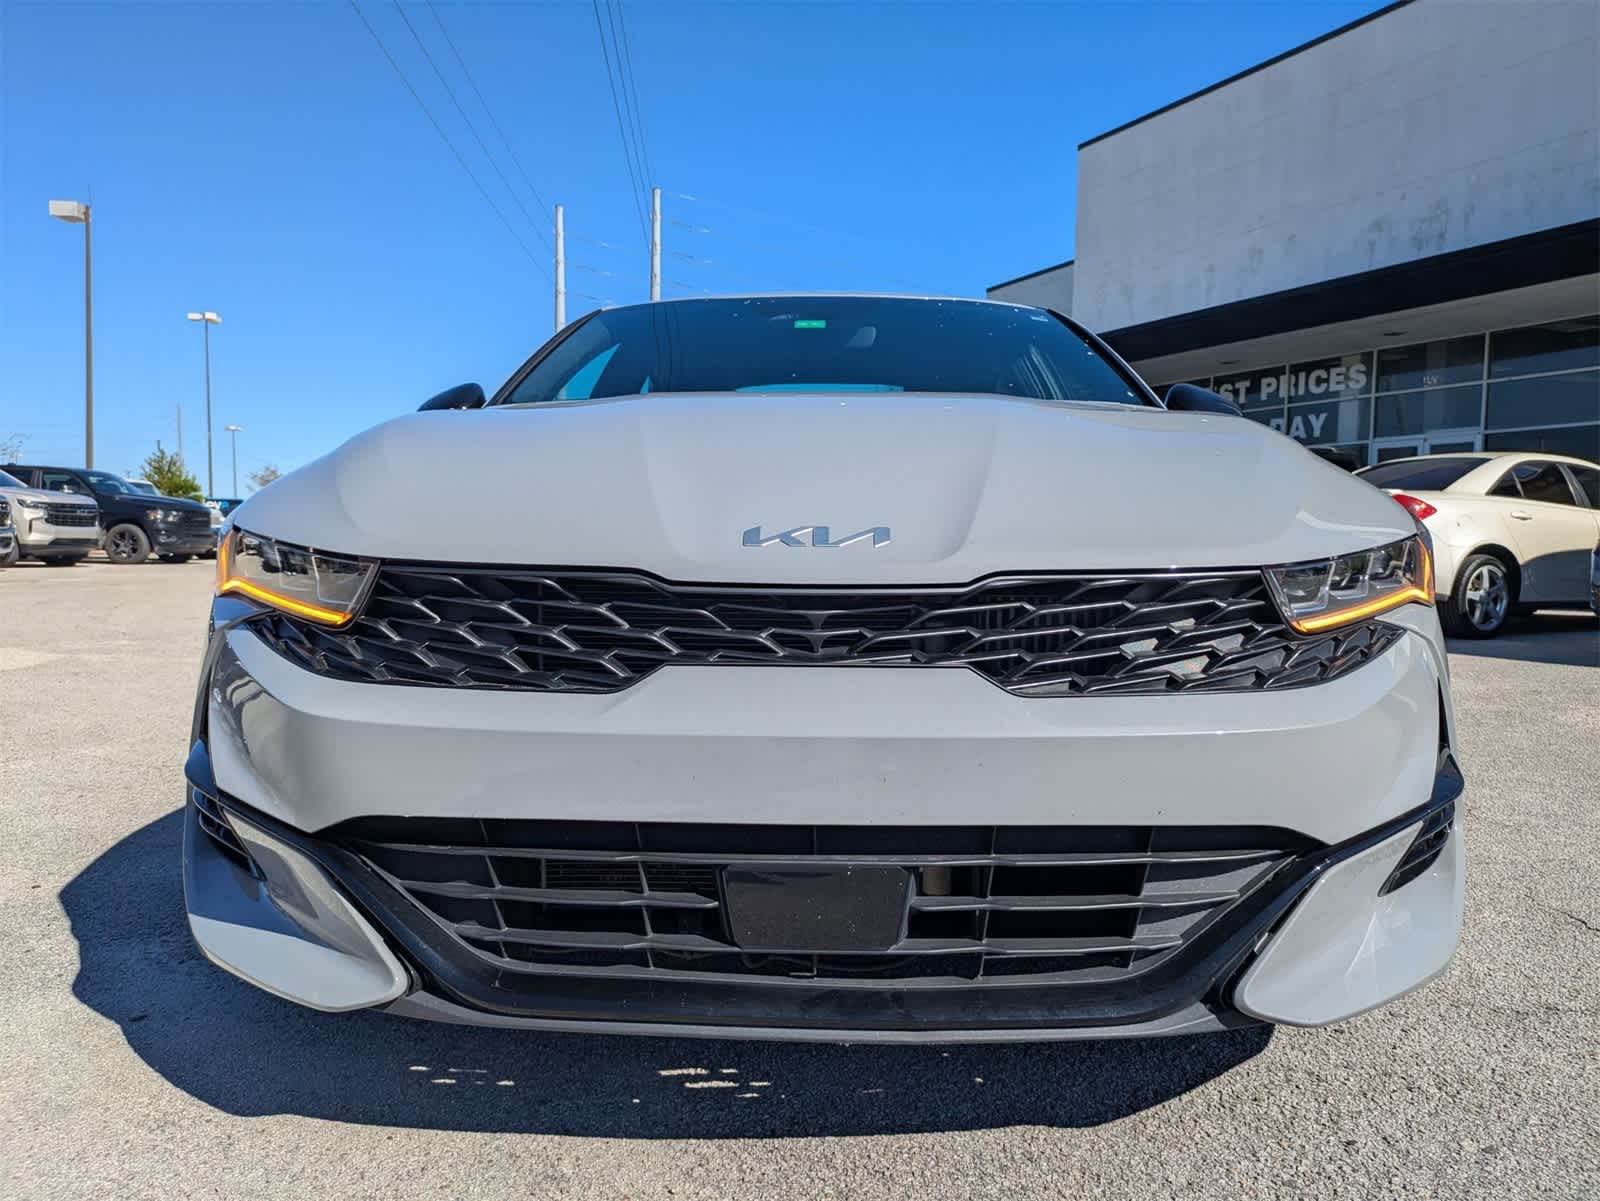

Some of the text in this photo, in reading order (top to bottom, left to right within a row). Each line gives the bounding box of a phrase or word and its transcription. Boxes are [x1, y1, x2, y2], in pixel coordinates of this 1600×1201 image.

[1214, 363, 1367, 404] ST PRICES
[743, 526, 891, 548] KIA
